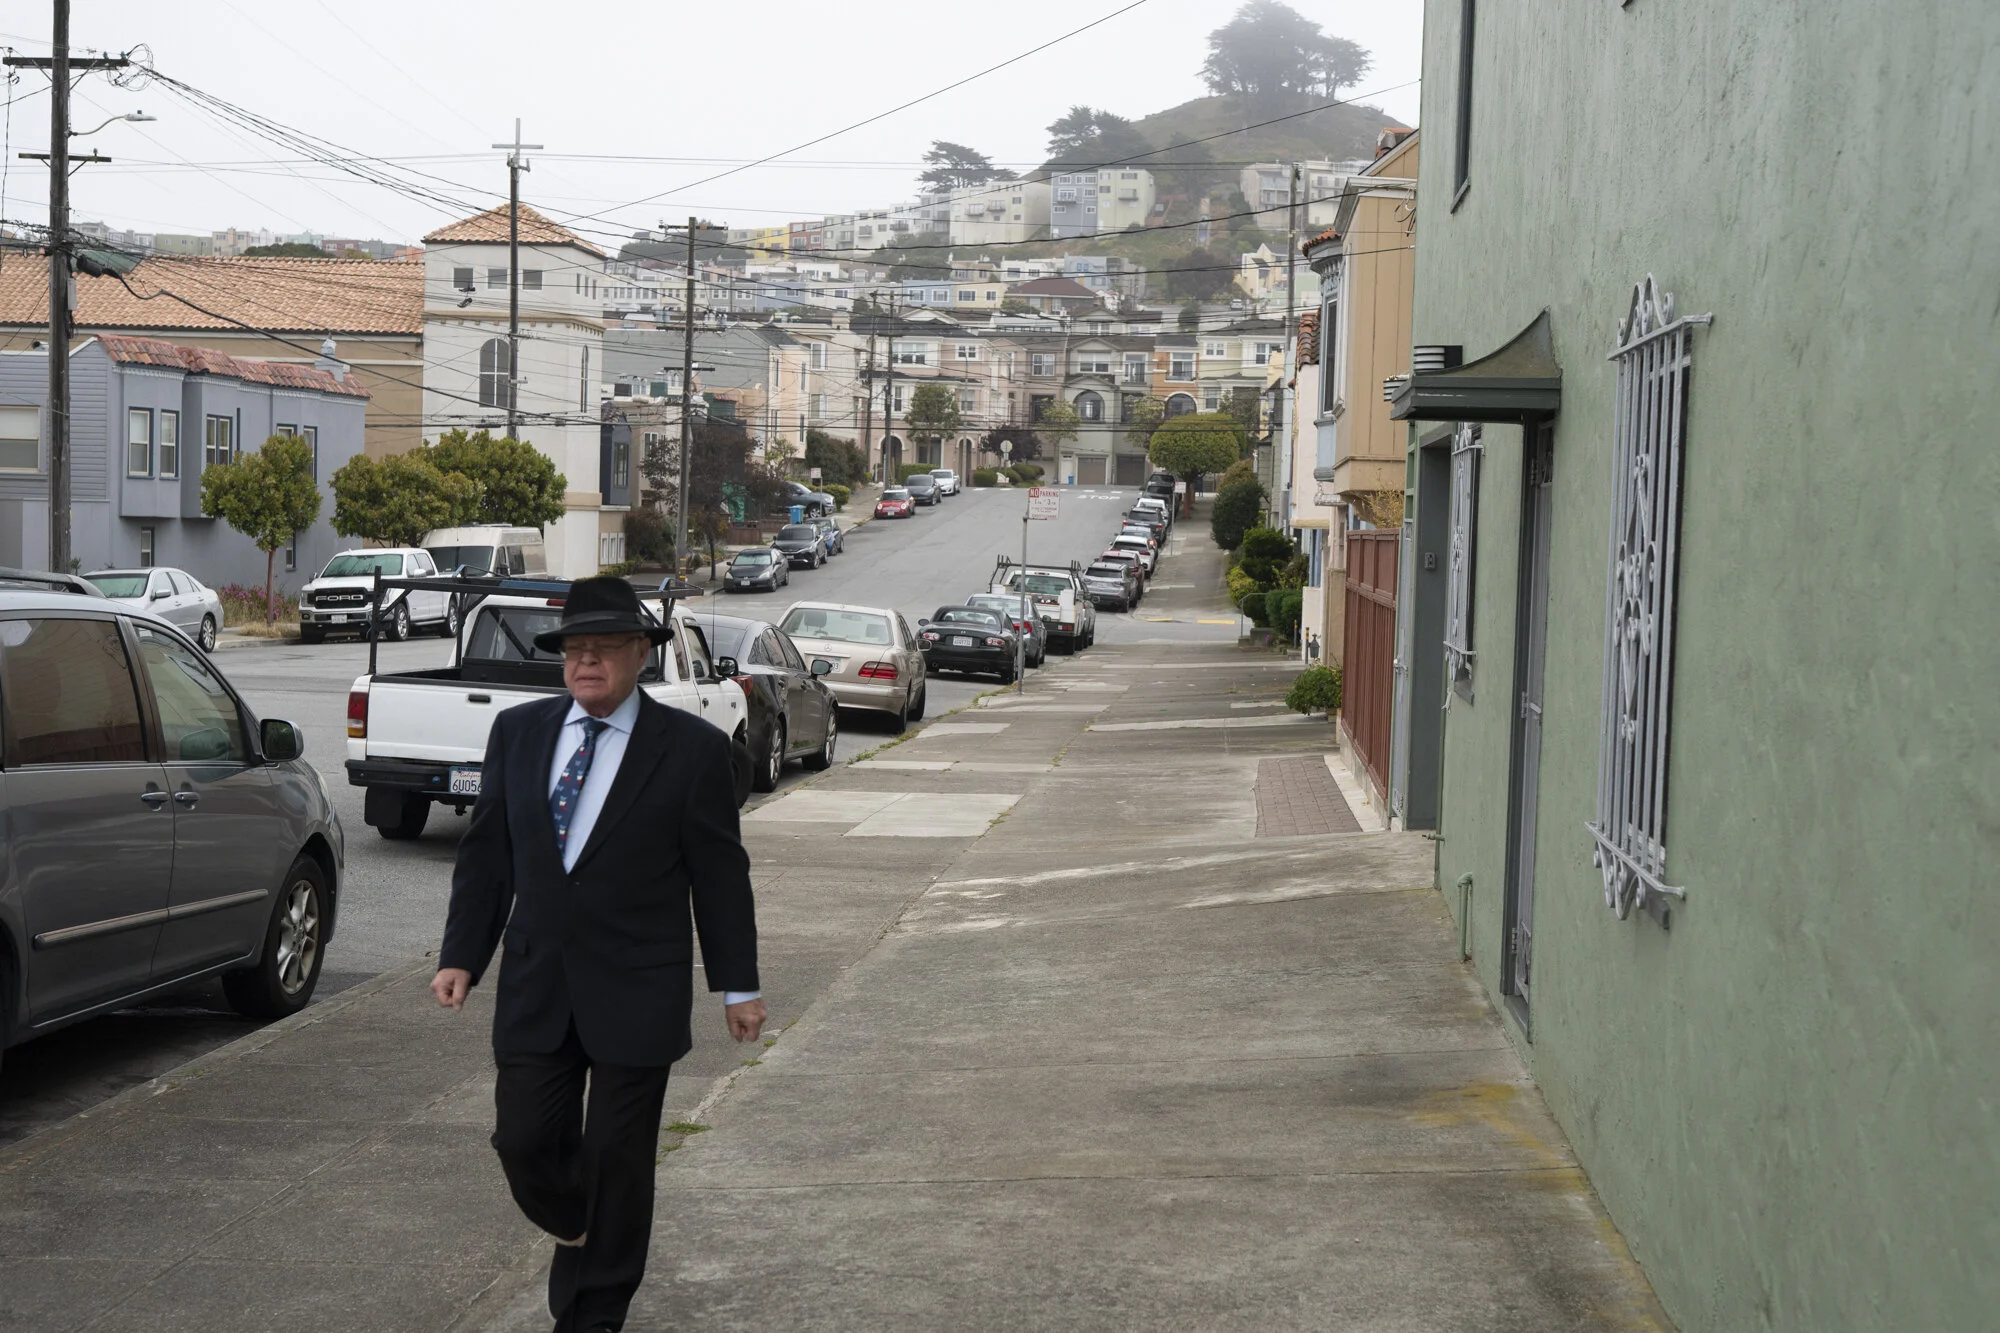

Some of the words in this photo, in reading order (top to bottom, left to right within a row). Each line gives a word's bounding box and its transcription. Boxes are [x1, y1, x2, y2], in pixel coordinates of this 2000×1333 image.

[1030, 488, 1039, 497] NO
[315, 594, 364, 602] FORD
[452, 779, 482, 793] 6U056
